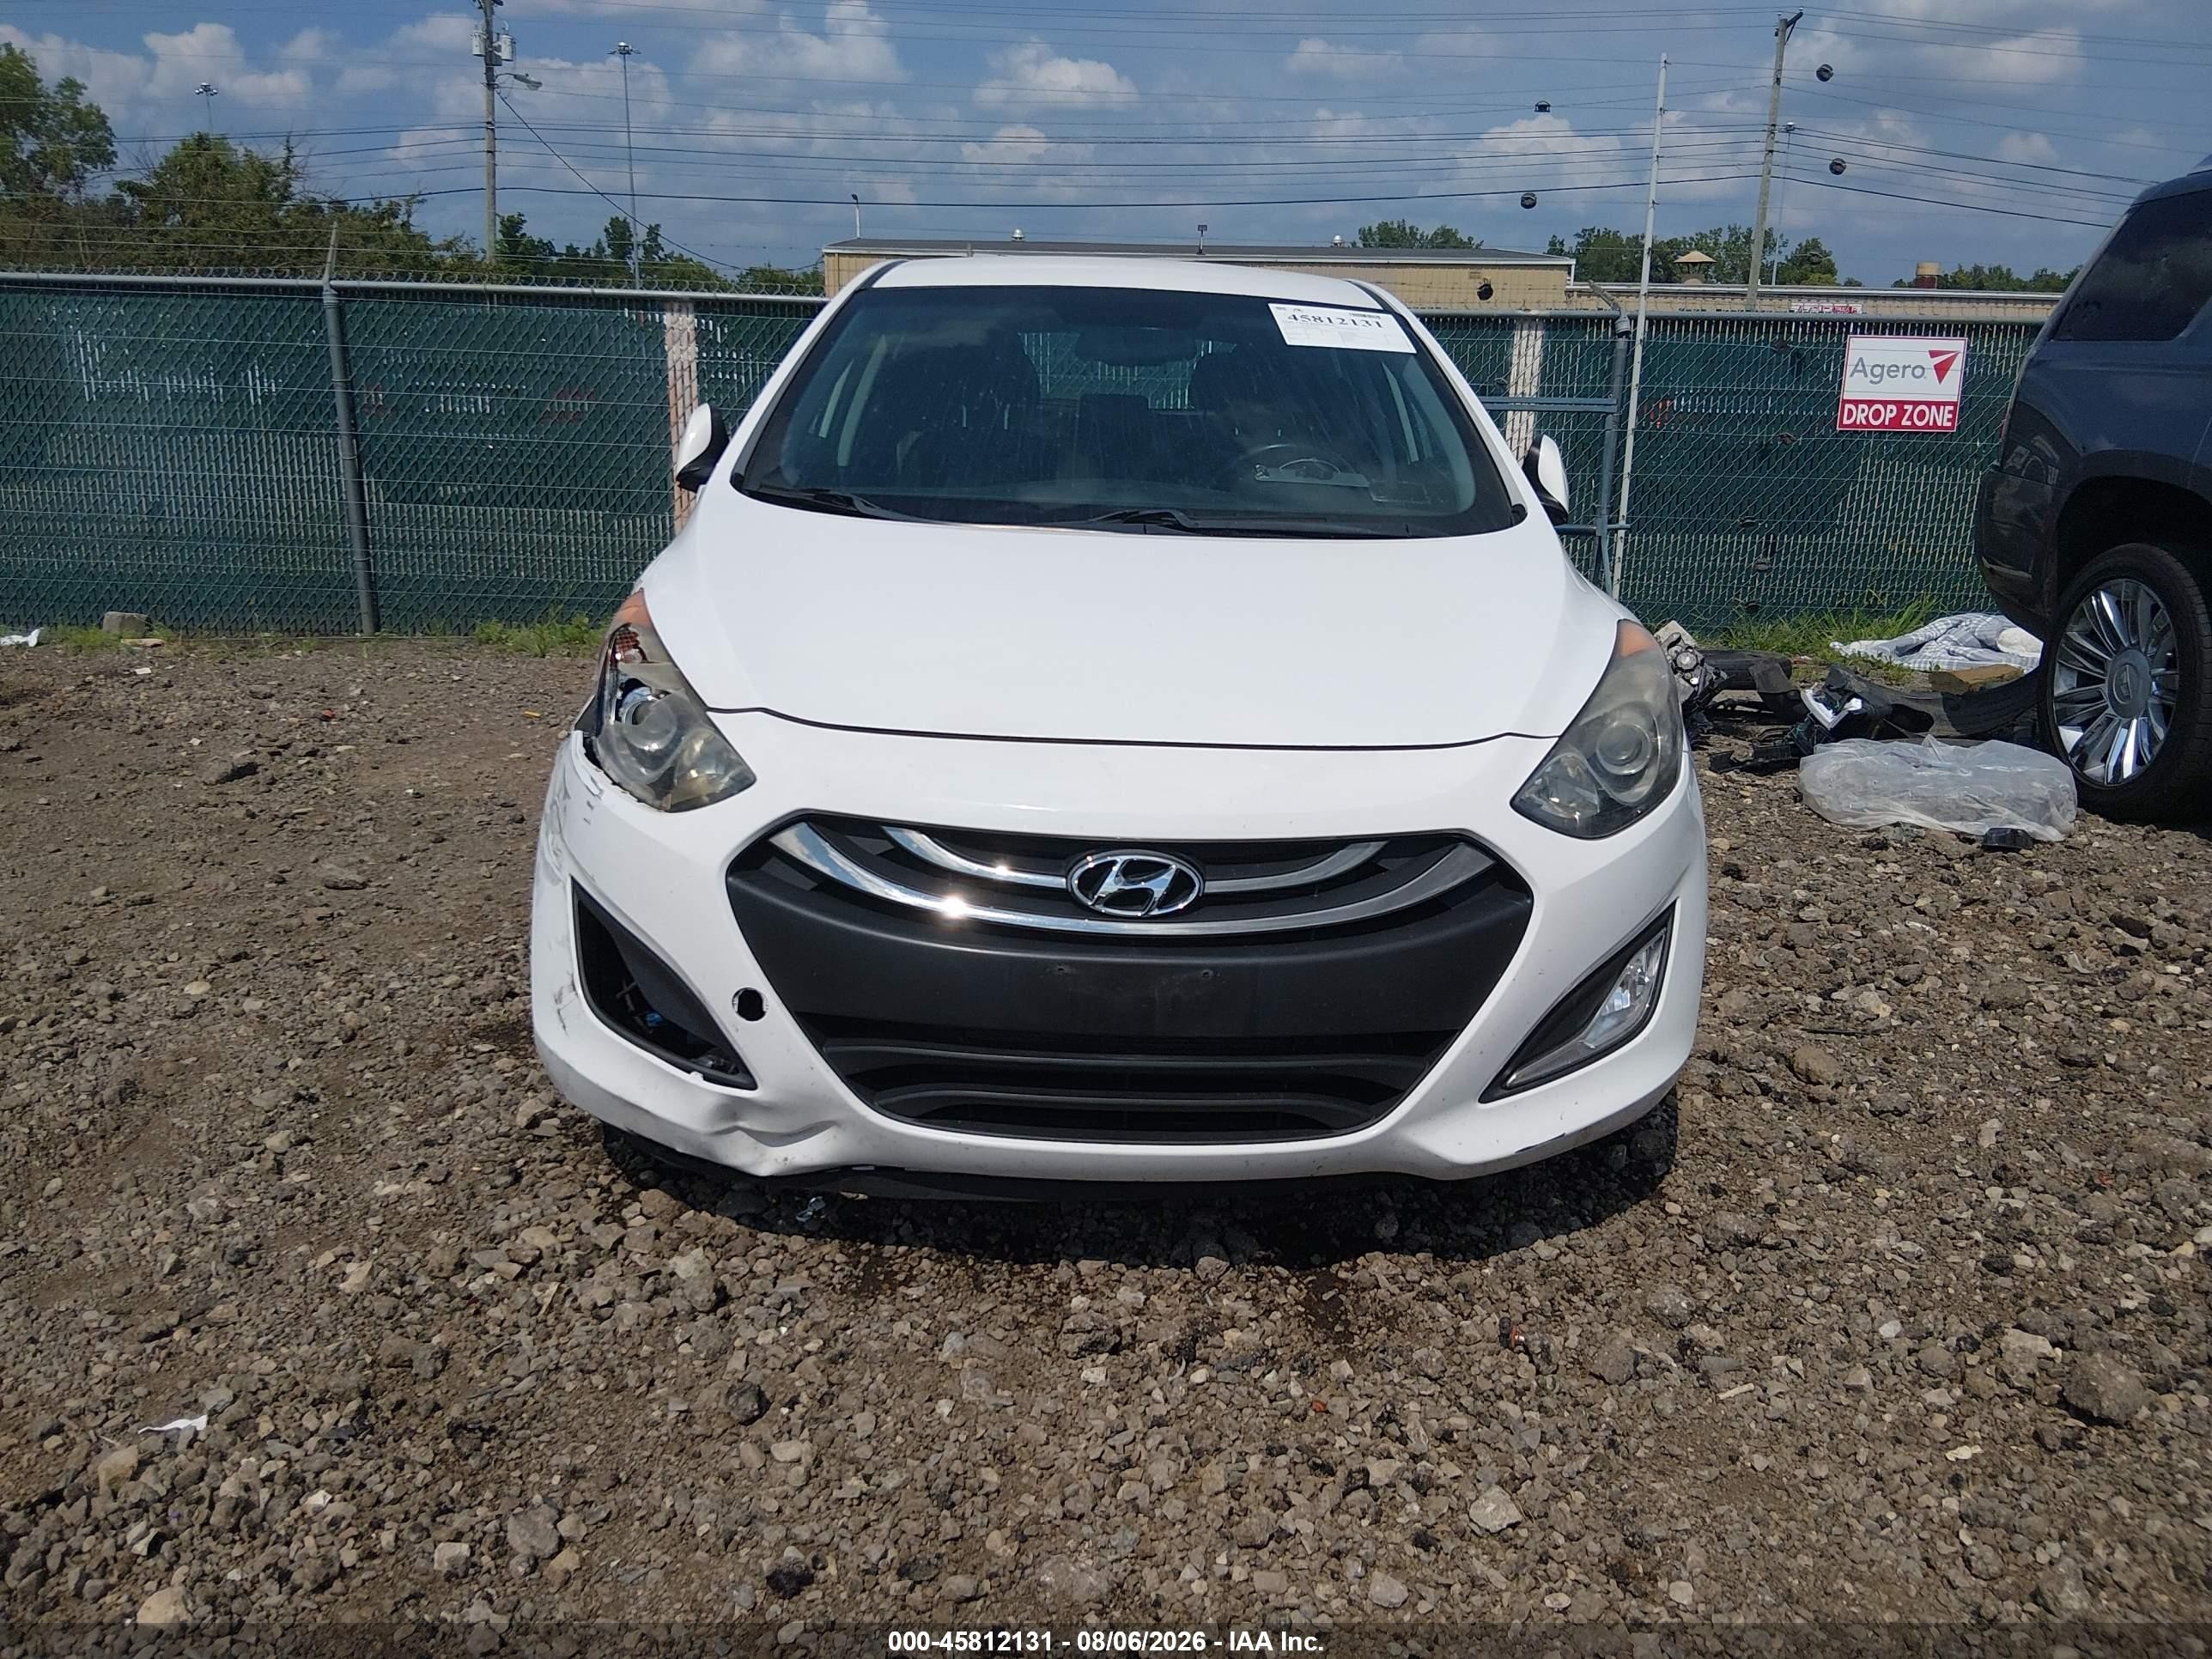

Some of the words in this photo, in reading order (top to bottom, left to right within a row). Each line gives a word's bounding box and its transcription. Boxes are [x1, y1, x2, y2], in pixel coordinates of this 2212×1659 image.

[1287, 313, 1383, 328] 45812131
[1850, 356, 1926, 385] Agero
[1842, 404, 1897, 426] DROP
[1900, 404, 1954, 427] ZONE
